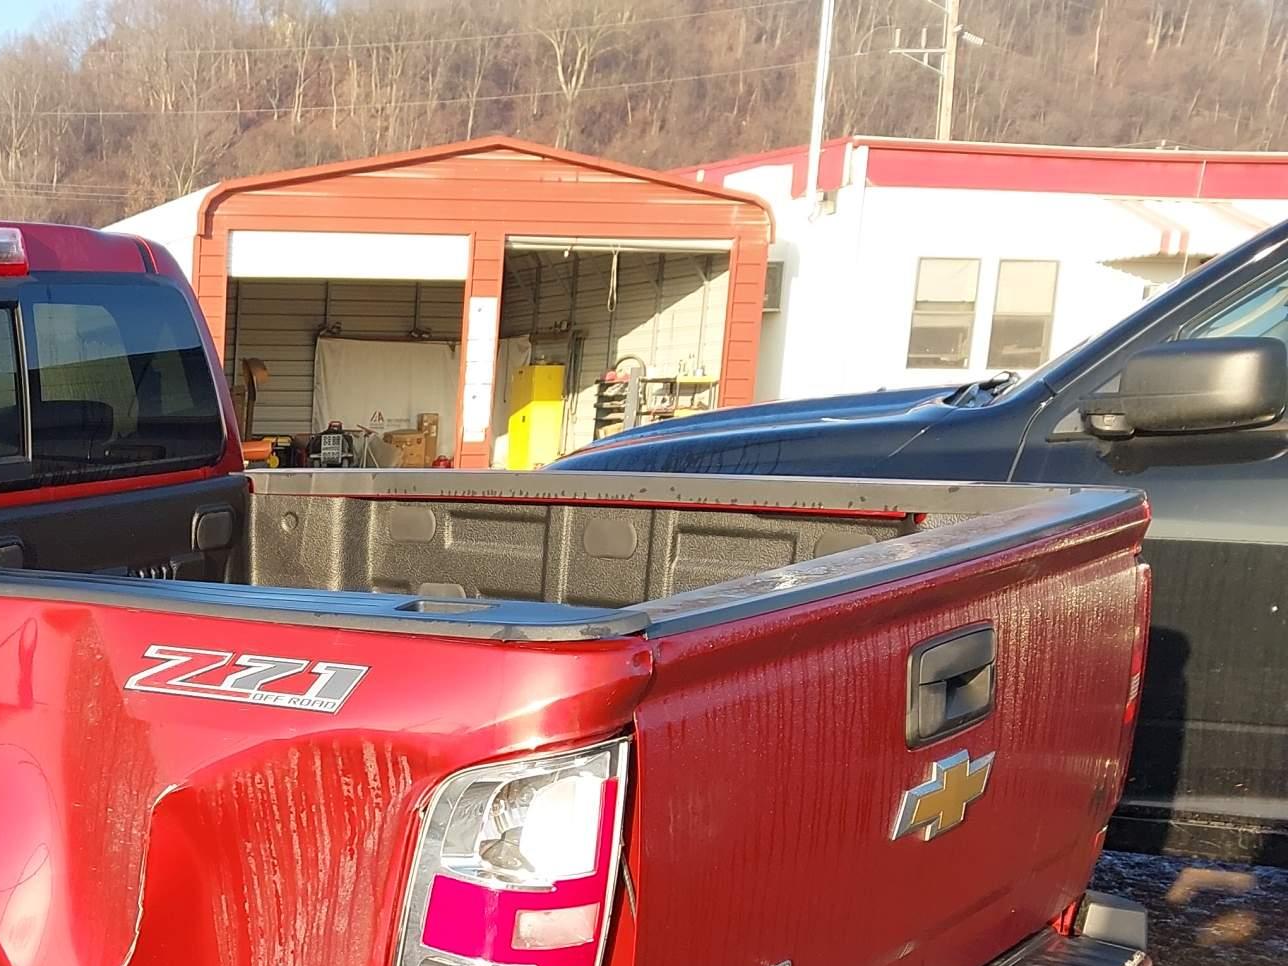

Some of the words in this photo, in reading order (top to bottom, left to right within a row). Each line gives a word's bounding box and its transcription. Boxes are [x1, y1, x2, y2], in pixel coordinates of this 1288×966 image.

[123, 643, 372, 715] Z71
[251, 692, 286, 704] OFF
[288, 696, 338, 711] ROAD
